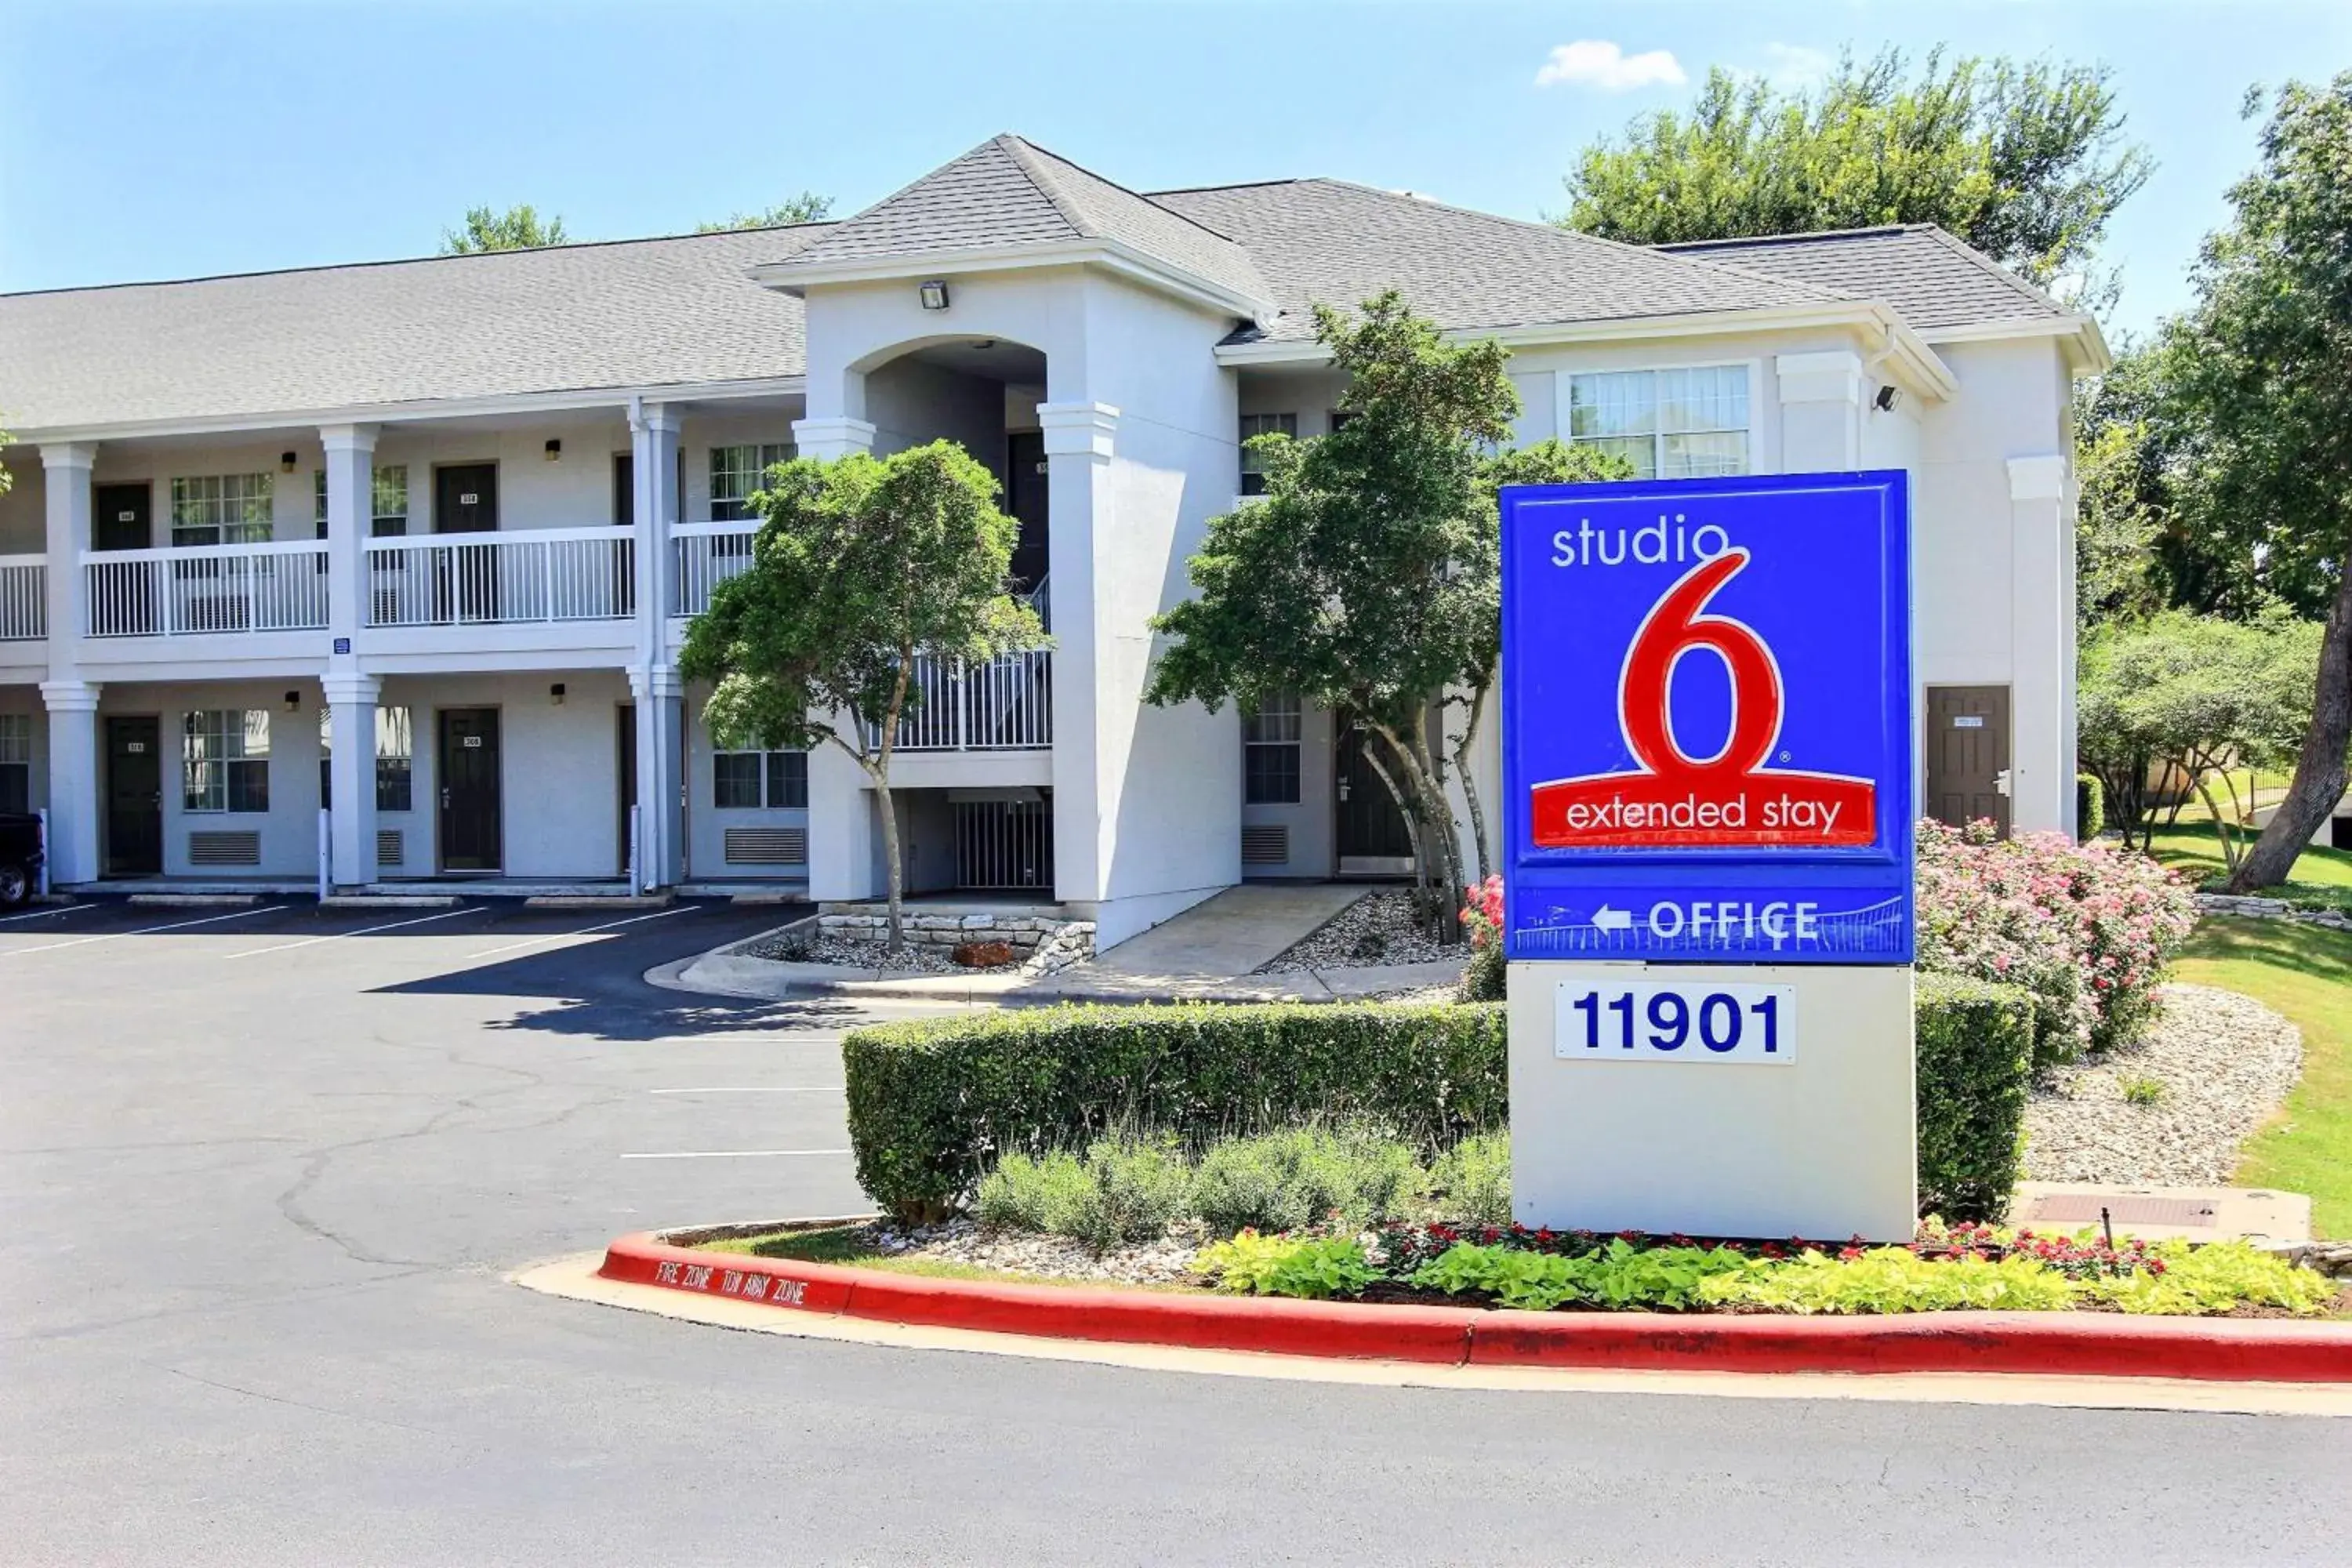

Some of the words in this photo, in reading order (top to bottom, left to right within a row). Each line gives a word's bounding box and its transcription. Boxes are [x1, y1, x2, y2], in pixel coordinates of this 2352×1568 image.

[1552, 514, 1729, 567] studio
[1617, 546, 1785, 775] 6
[1567, 793, 1746, 828] extended
[1762, 793, 1842, 834] stay
[1649, 901, 1818, 939] OFFICE
[1573, 992, 1777, 1053] 11901
[655, 1261, 682, 1283] FIRE
[682, 1265, 713, 1290] ZONE
[722, 1269, 743, 1293] TOW
[741, 1273, 771, 1299] AWAY
[773, 1279, 808, 1305] ZONE
